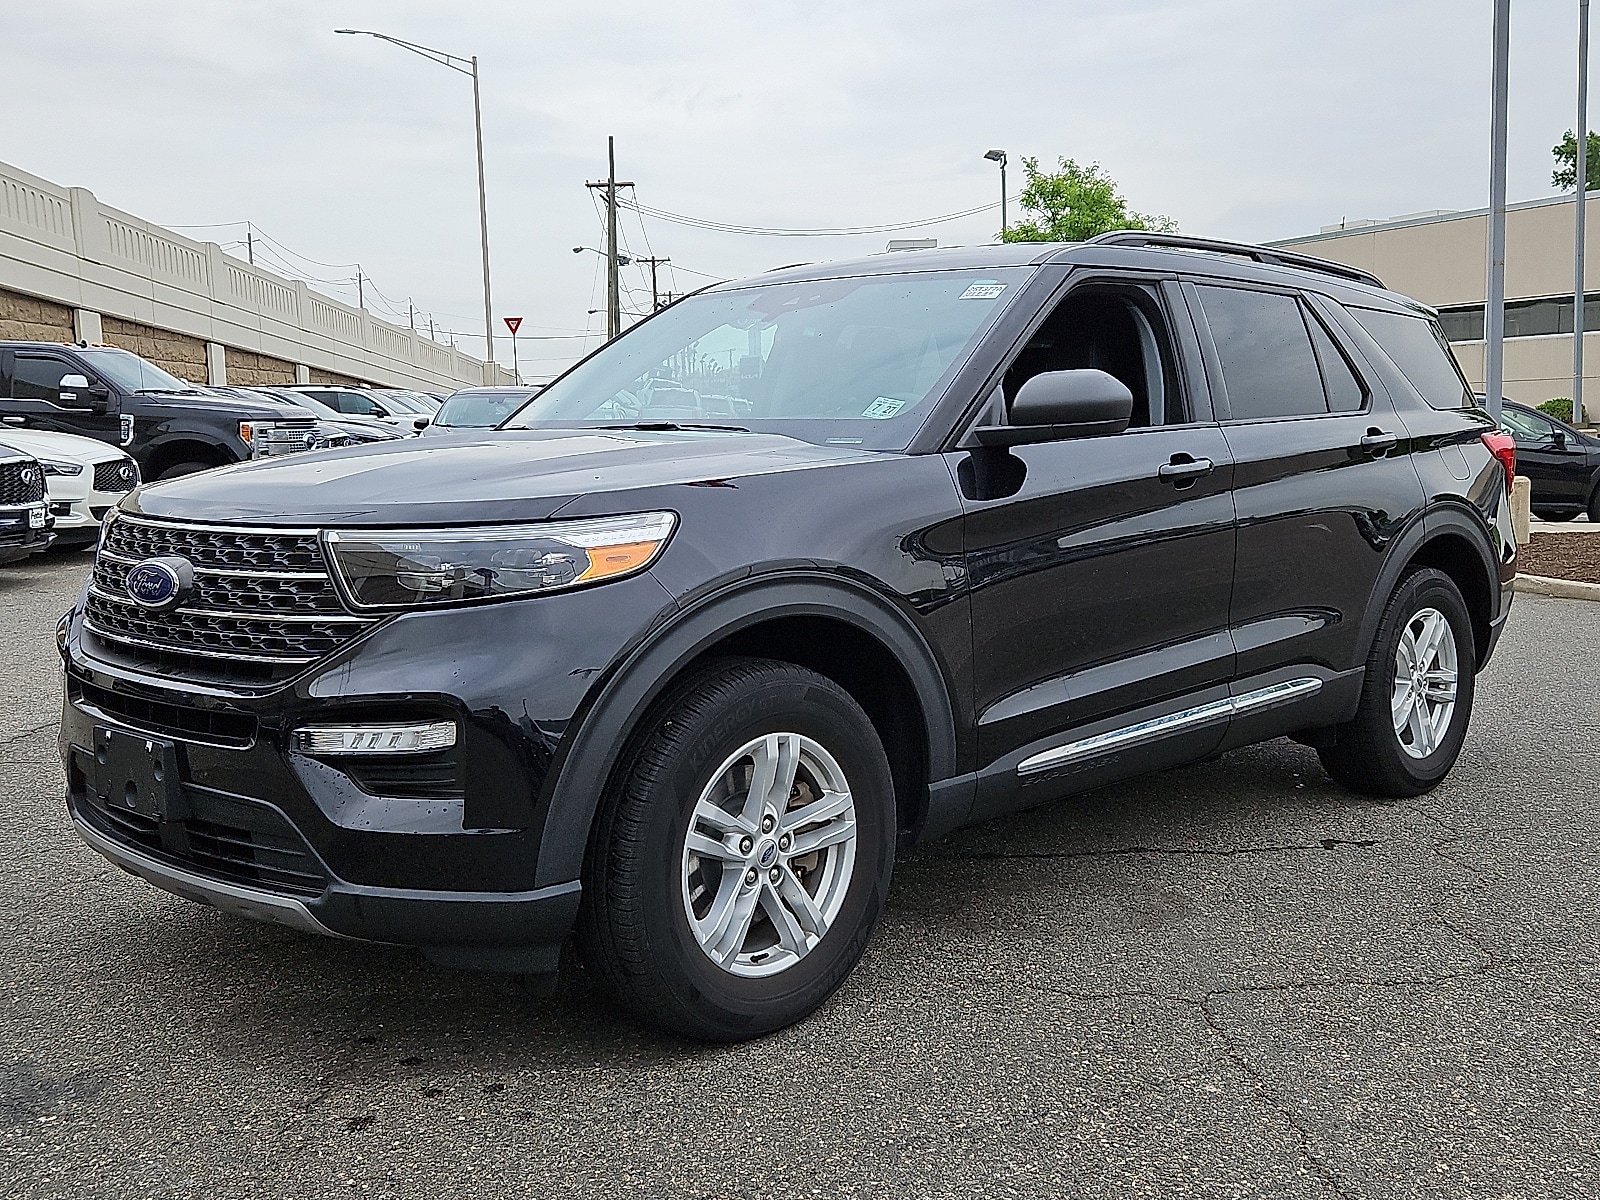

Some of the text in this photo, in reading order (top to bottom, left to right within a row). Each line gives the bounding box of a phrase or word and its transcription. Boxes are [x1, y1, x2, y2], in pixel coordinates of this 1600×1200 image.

[871, 403, 882, 412] 7
[882, 405, 897, 415] 27
[133, 569, 164, 594] Ford
